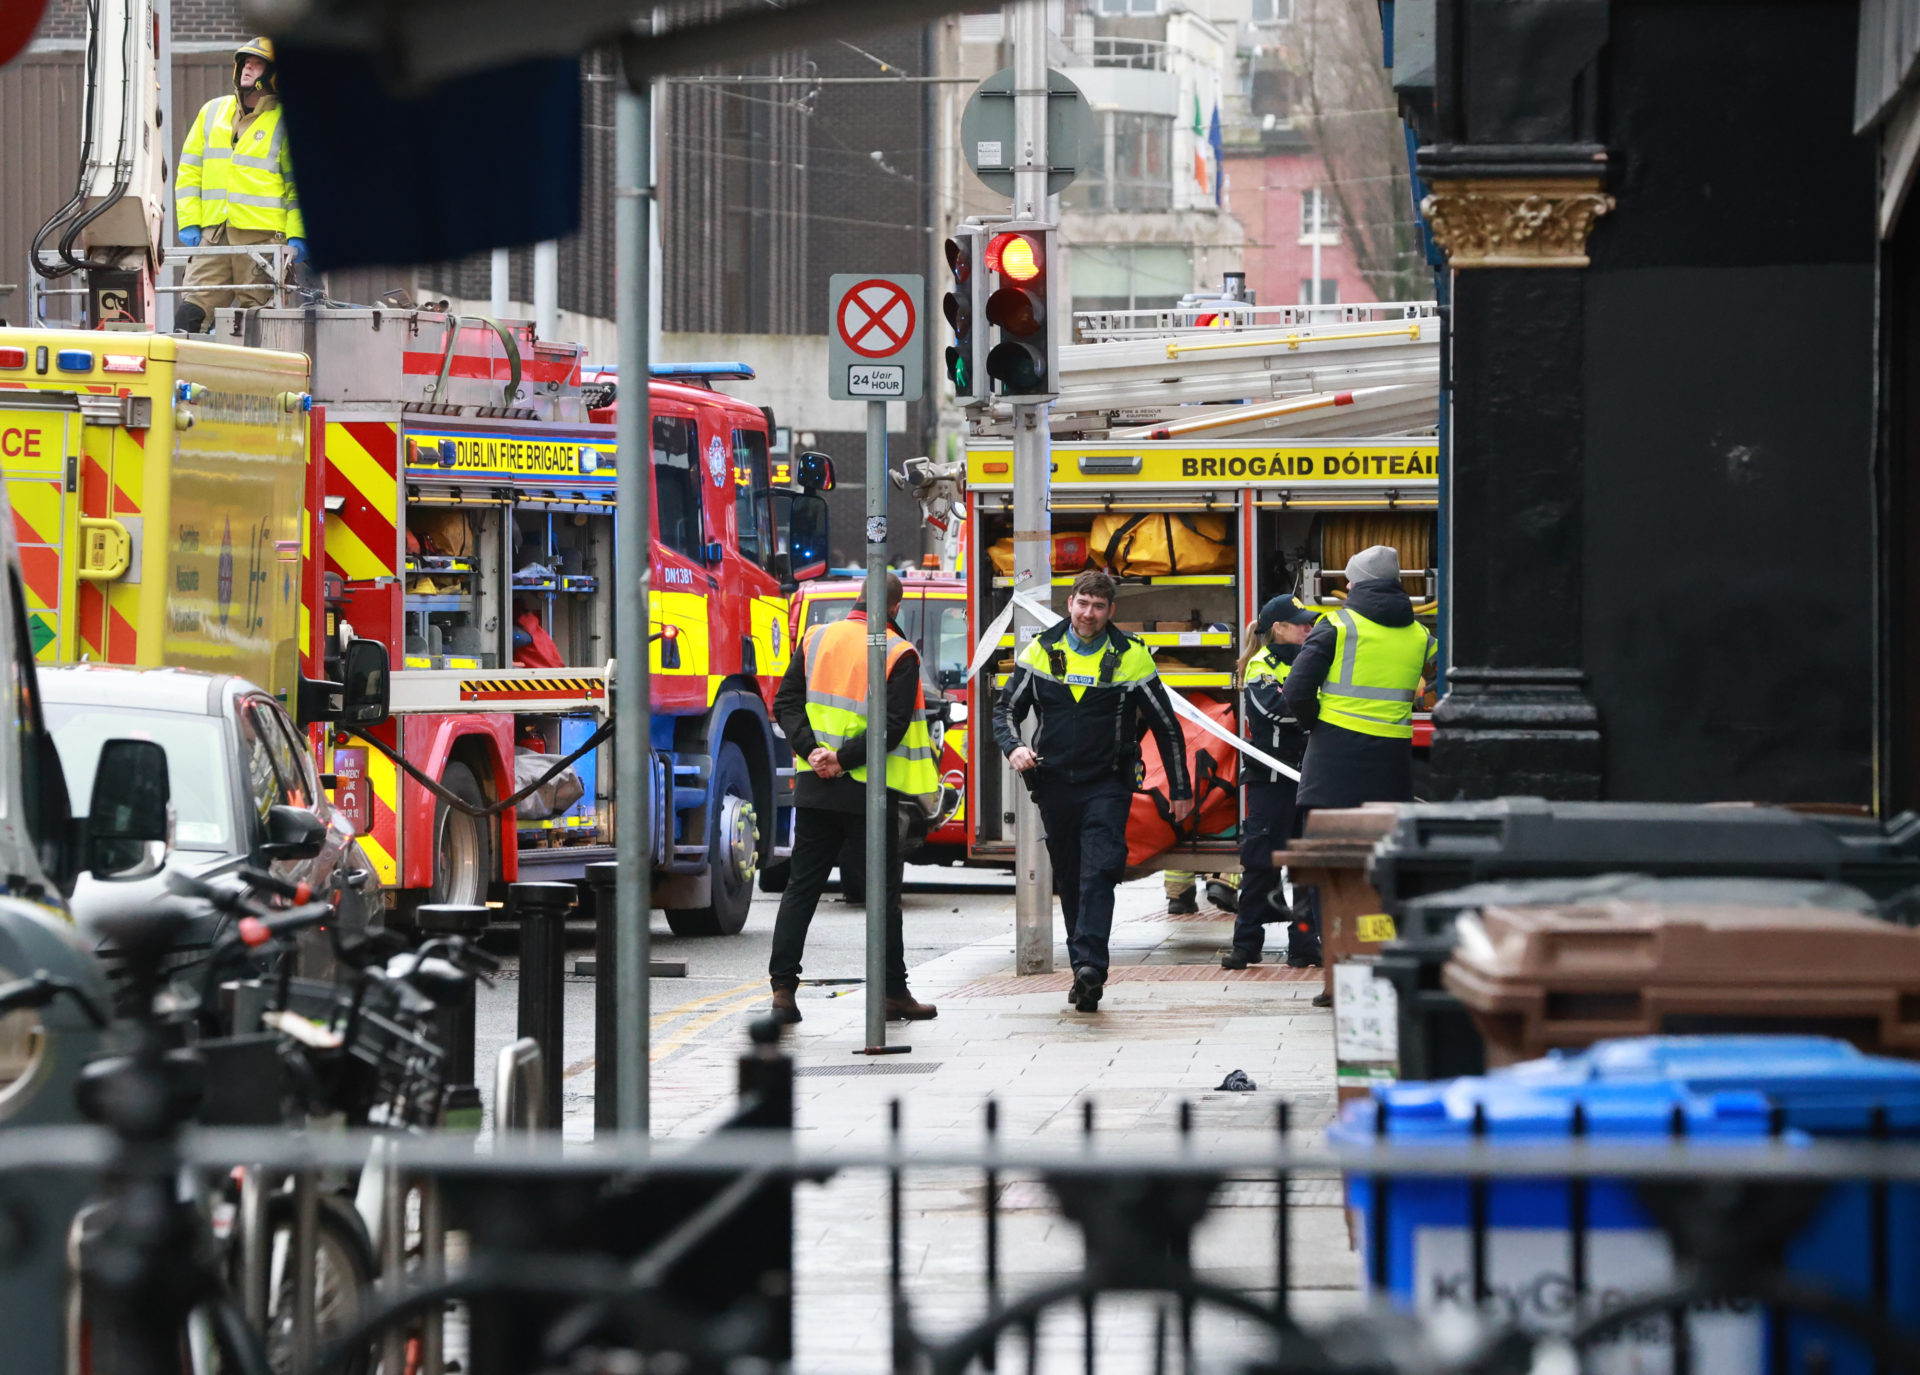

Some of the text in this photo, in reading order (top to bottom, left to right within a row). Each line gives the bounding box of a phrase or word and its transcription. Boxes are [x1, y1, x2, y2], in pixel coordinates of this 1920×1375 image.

[852, 375, 869, 385] 24
[872, 371, 892, 379] Uair
[871, 381, 899, 390] HOUR
[457, 440, 574, 471] DUBLIN FIRE BRIGADE
[1181, 451, 1439, 477] BRIOGÁID DÓITEÁI
